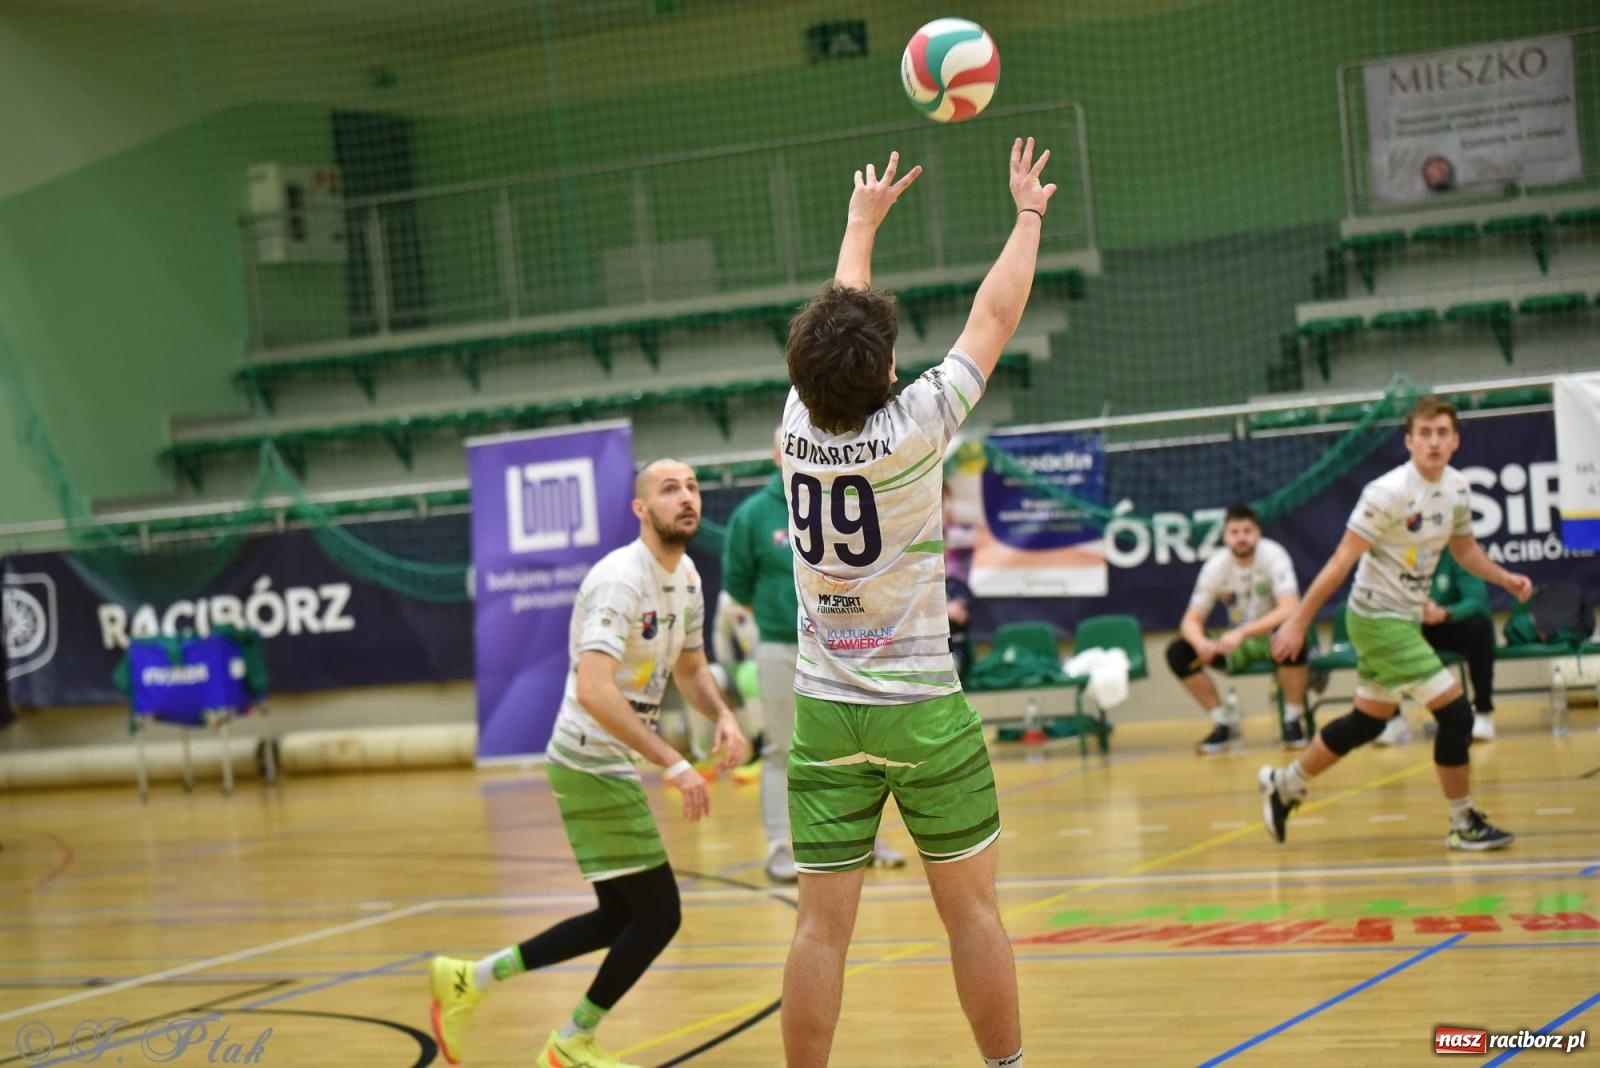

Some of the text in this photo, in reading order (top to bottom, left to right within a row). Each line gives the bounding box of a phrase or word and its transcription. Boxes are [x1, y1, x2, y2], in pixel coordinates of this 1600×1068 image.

[1390, 46, 1548, 94] MIESZKO
[783, 431, 893, 465] EDNARCZYK
[791, 472, 882, 567] 99
[832, 596, 862, 607] SPORT
[817, 604, 866, 615] FOUNDATION
[827, 626, 896, 640] KULTURALNE
[828, 637, 894, 651] ZAWIERCIE
